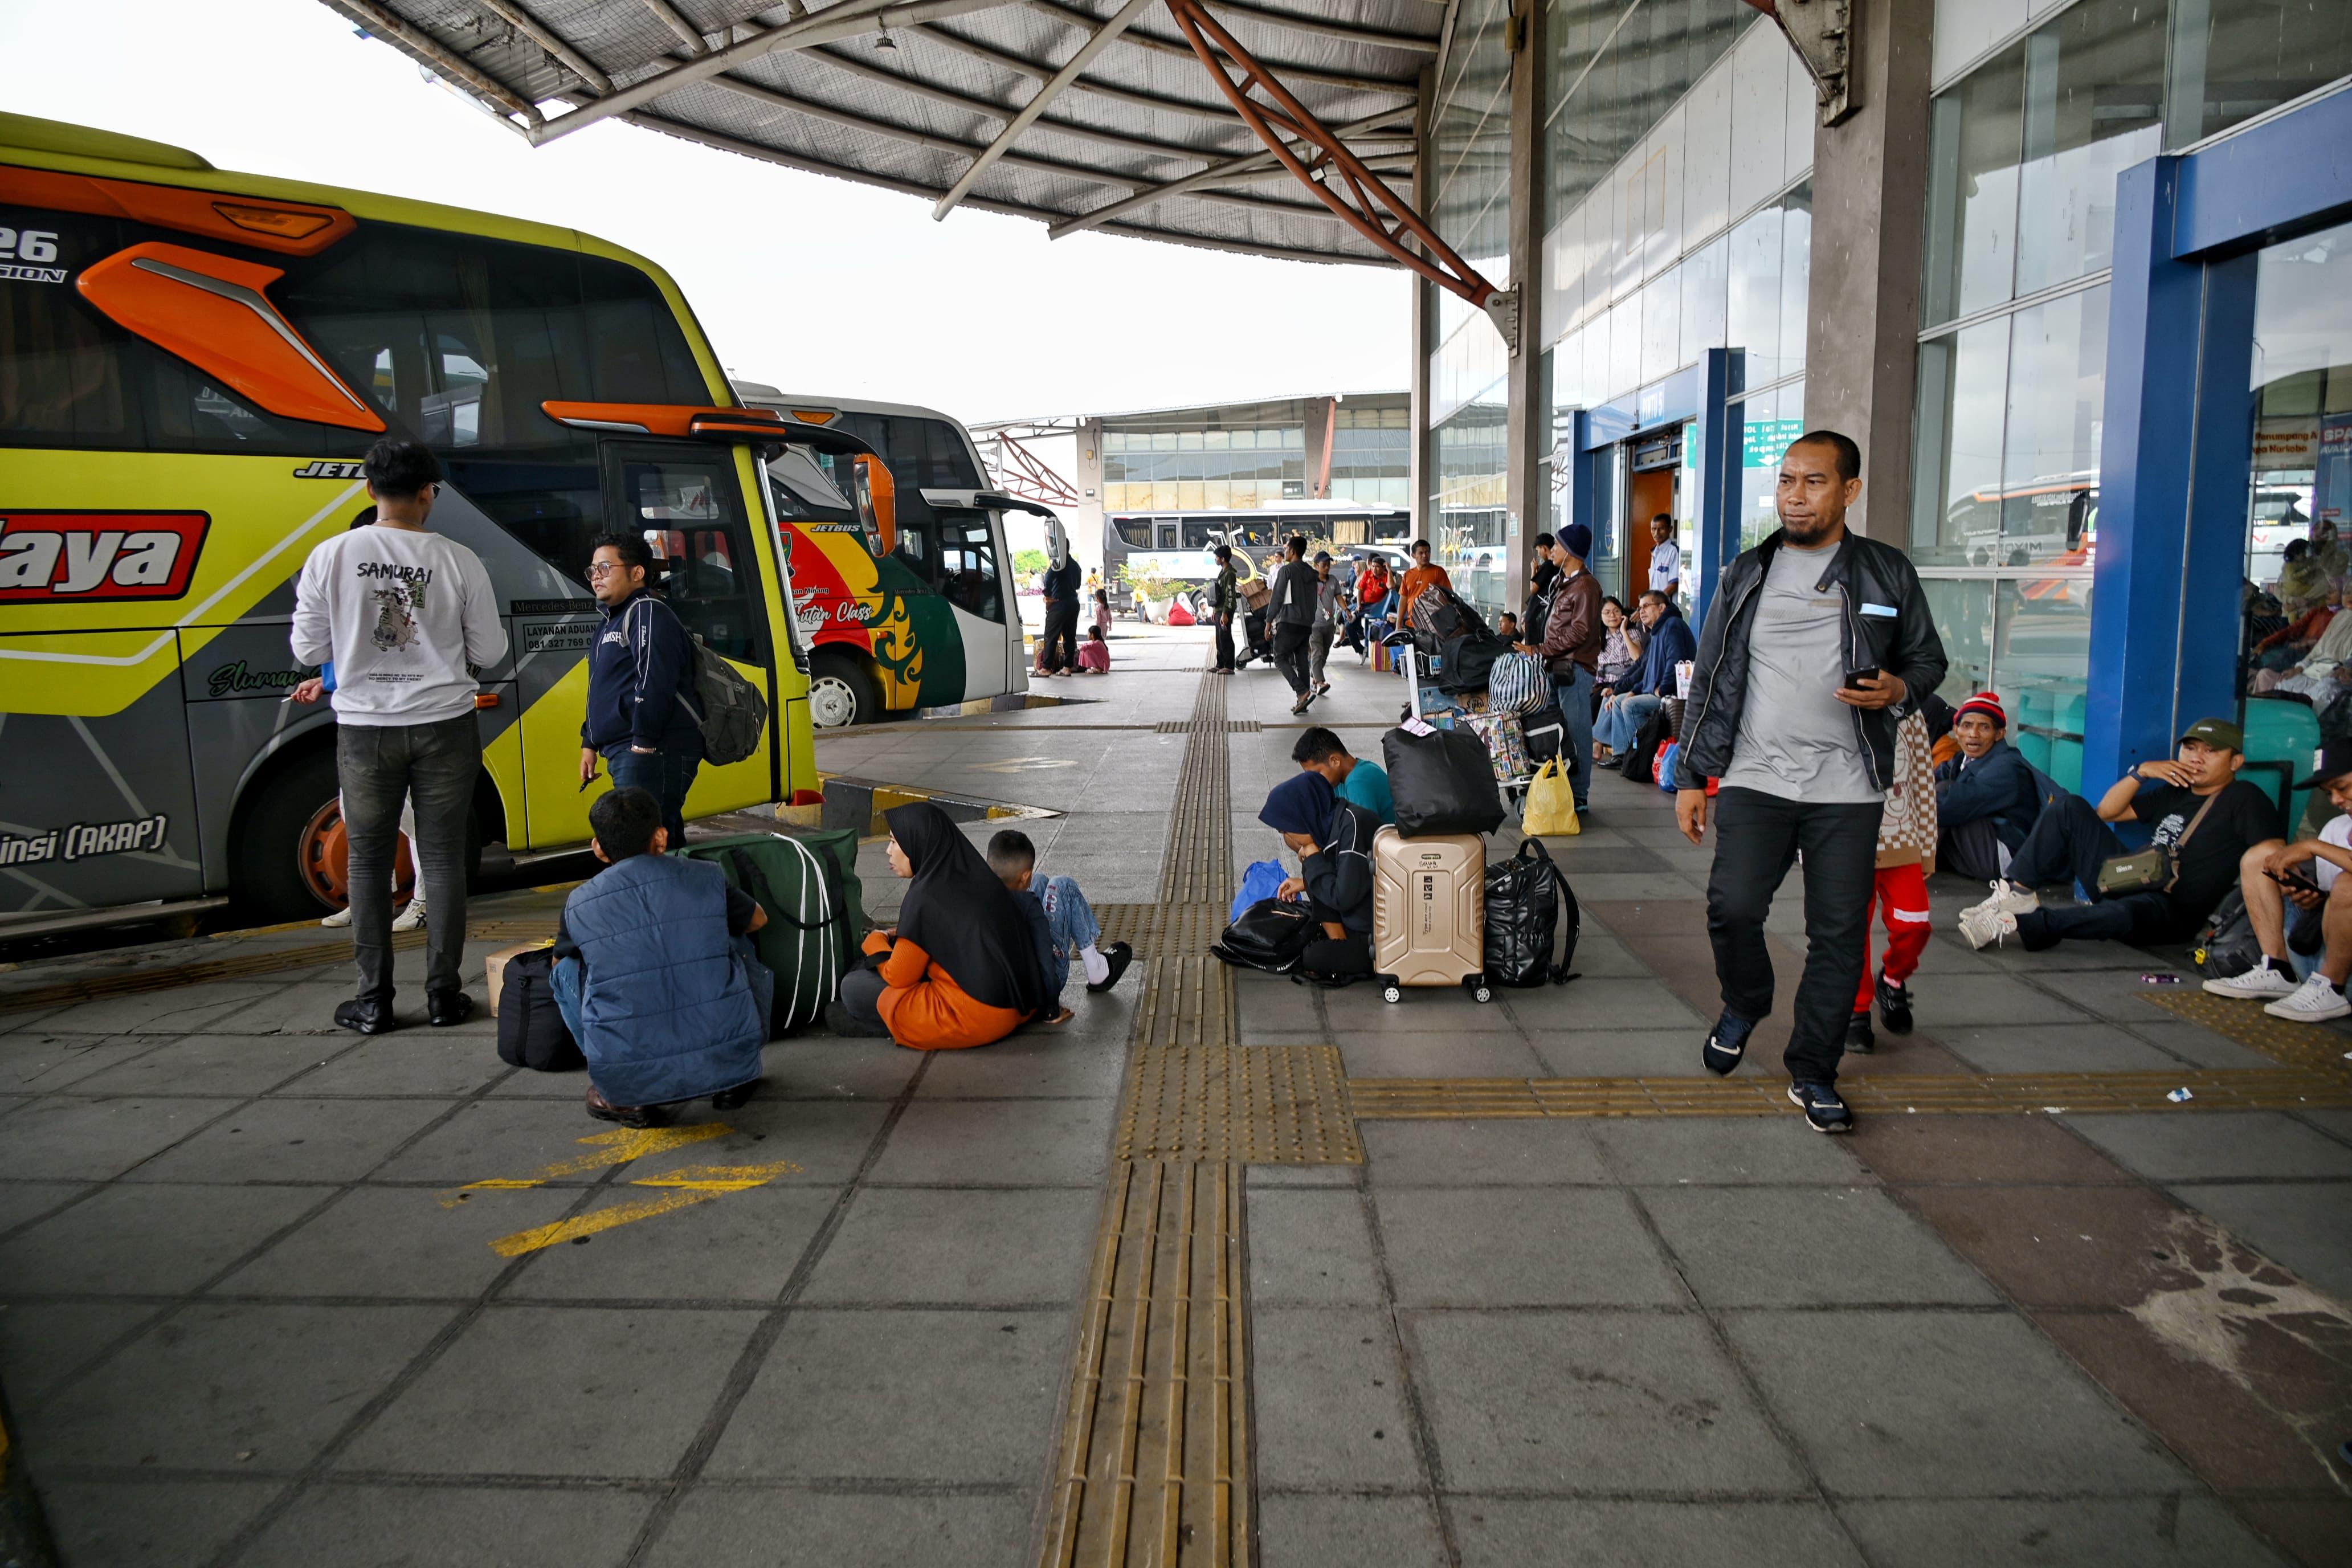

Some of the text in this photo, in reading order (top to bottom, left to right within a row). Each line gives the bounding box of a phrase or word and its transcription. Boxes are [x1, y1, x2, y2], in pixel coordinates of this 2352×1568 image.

[2255, 432, 2309, 442] Penumpang
[2269, 444, 2308, 453] Narkoba
[0, 519, 182, 593] aya
[357, 562, 432, 584] SAMURAI
[516, 601, 594, 612] Mercedes-Benz
[836, 601, 874, 622] Class
[528, 624, 596, 636] LAYANAN ADUAN
[529, 640, 545, 649] 081
[549, 639, 564, 648] 327
[567, 638, 583, 647] 769
[64, 815, 166, 860] (AKAP)
